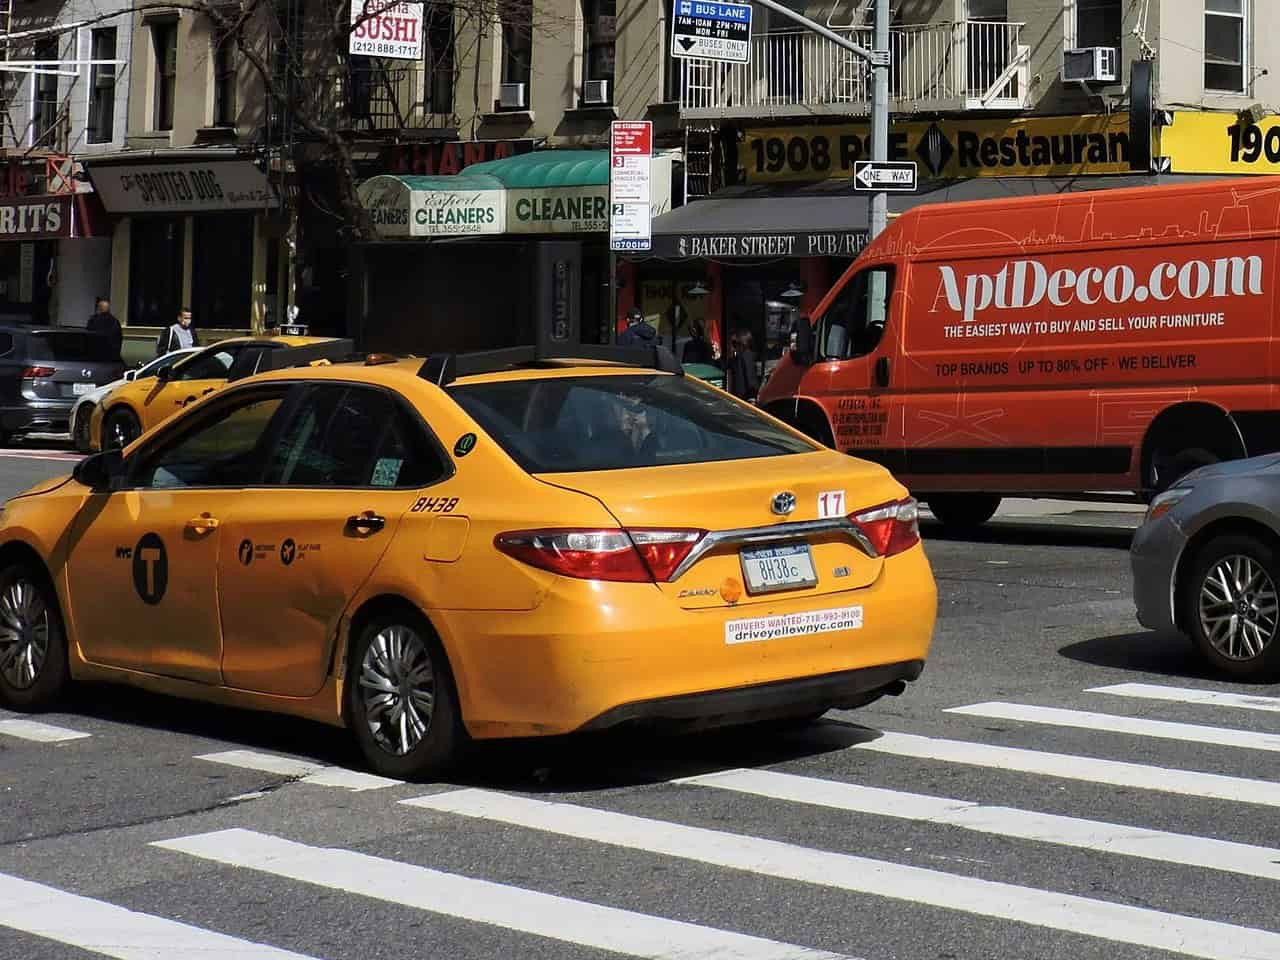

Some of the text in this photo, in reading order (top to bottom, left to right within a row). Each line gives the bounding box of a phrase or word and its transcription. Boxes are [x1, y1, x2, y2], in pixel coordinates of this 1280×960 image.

[696, 4, 745, 19] BUS LANE
[354, 16, 417, 42] SUSHI
[353, 41, 375, 52] (212)
[751, 135, 832, 173] 1908
[957, 129, 1130, 169] Restauran
[135, 171, 193, 202] SPOTTED
[190, 169, 224, 198] DOG
[863, 170, 912, 182] ONE WAY
[415, 207, 495, 225] CLEANERS
[516, 197, 609, 222] CLEANER
[691, 237, 737, 257] BAKER
[741, 235, 796, 256] STREET
[928, 255, 1265, 322] AptDeco.com
[944, 312, 1225, 338] THE EASIEST WAY TO BUY AND SELL YOUR FURNITURE
[936, 363, 957, 377] TOP
[961, 361, 1009, 375] BRANDS
[1018, 360, 1035, 374] UP
[1037, 360, 1053, 373] TO
[1084, 357, 1108, 372] OFF
[1118, 356, 1138, 370] WE
[1142, 354, 1196, 369] DELIVER
[411, 497, 460, 512] 8H38
[820, 493, 842, 516] 17
[115, 546, 132, 559] NYC
[729, 622, 766, 633] DRIVERS
[735, 620, 854, 642] driveyellownyc.com
